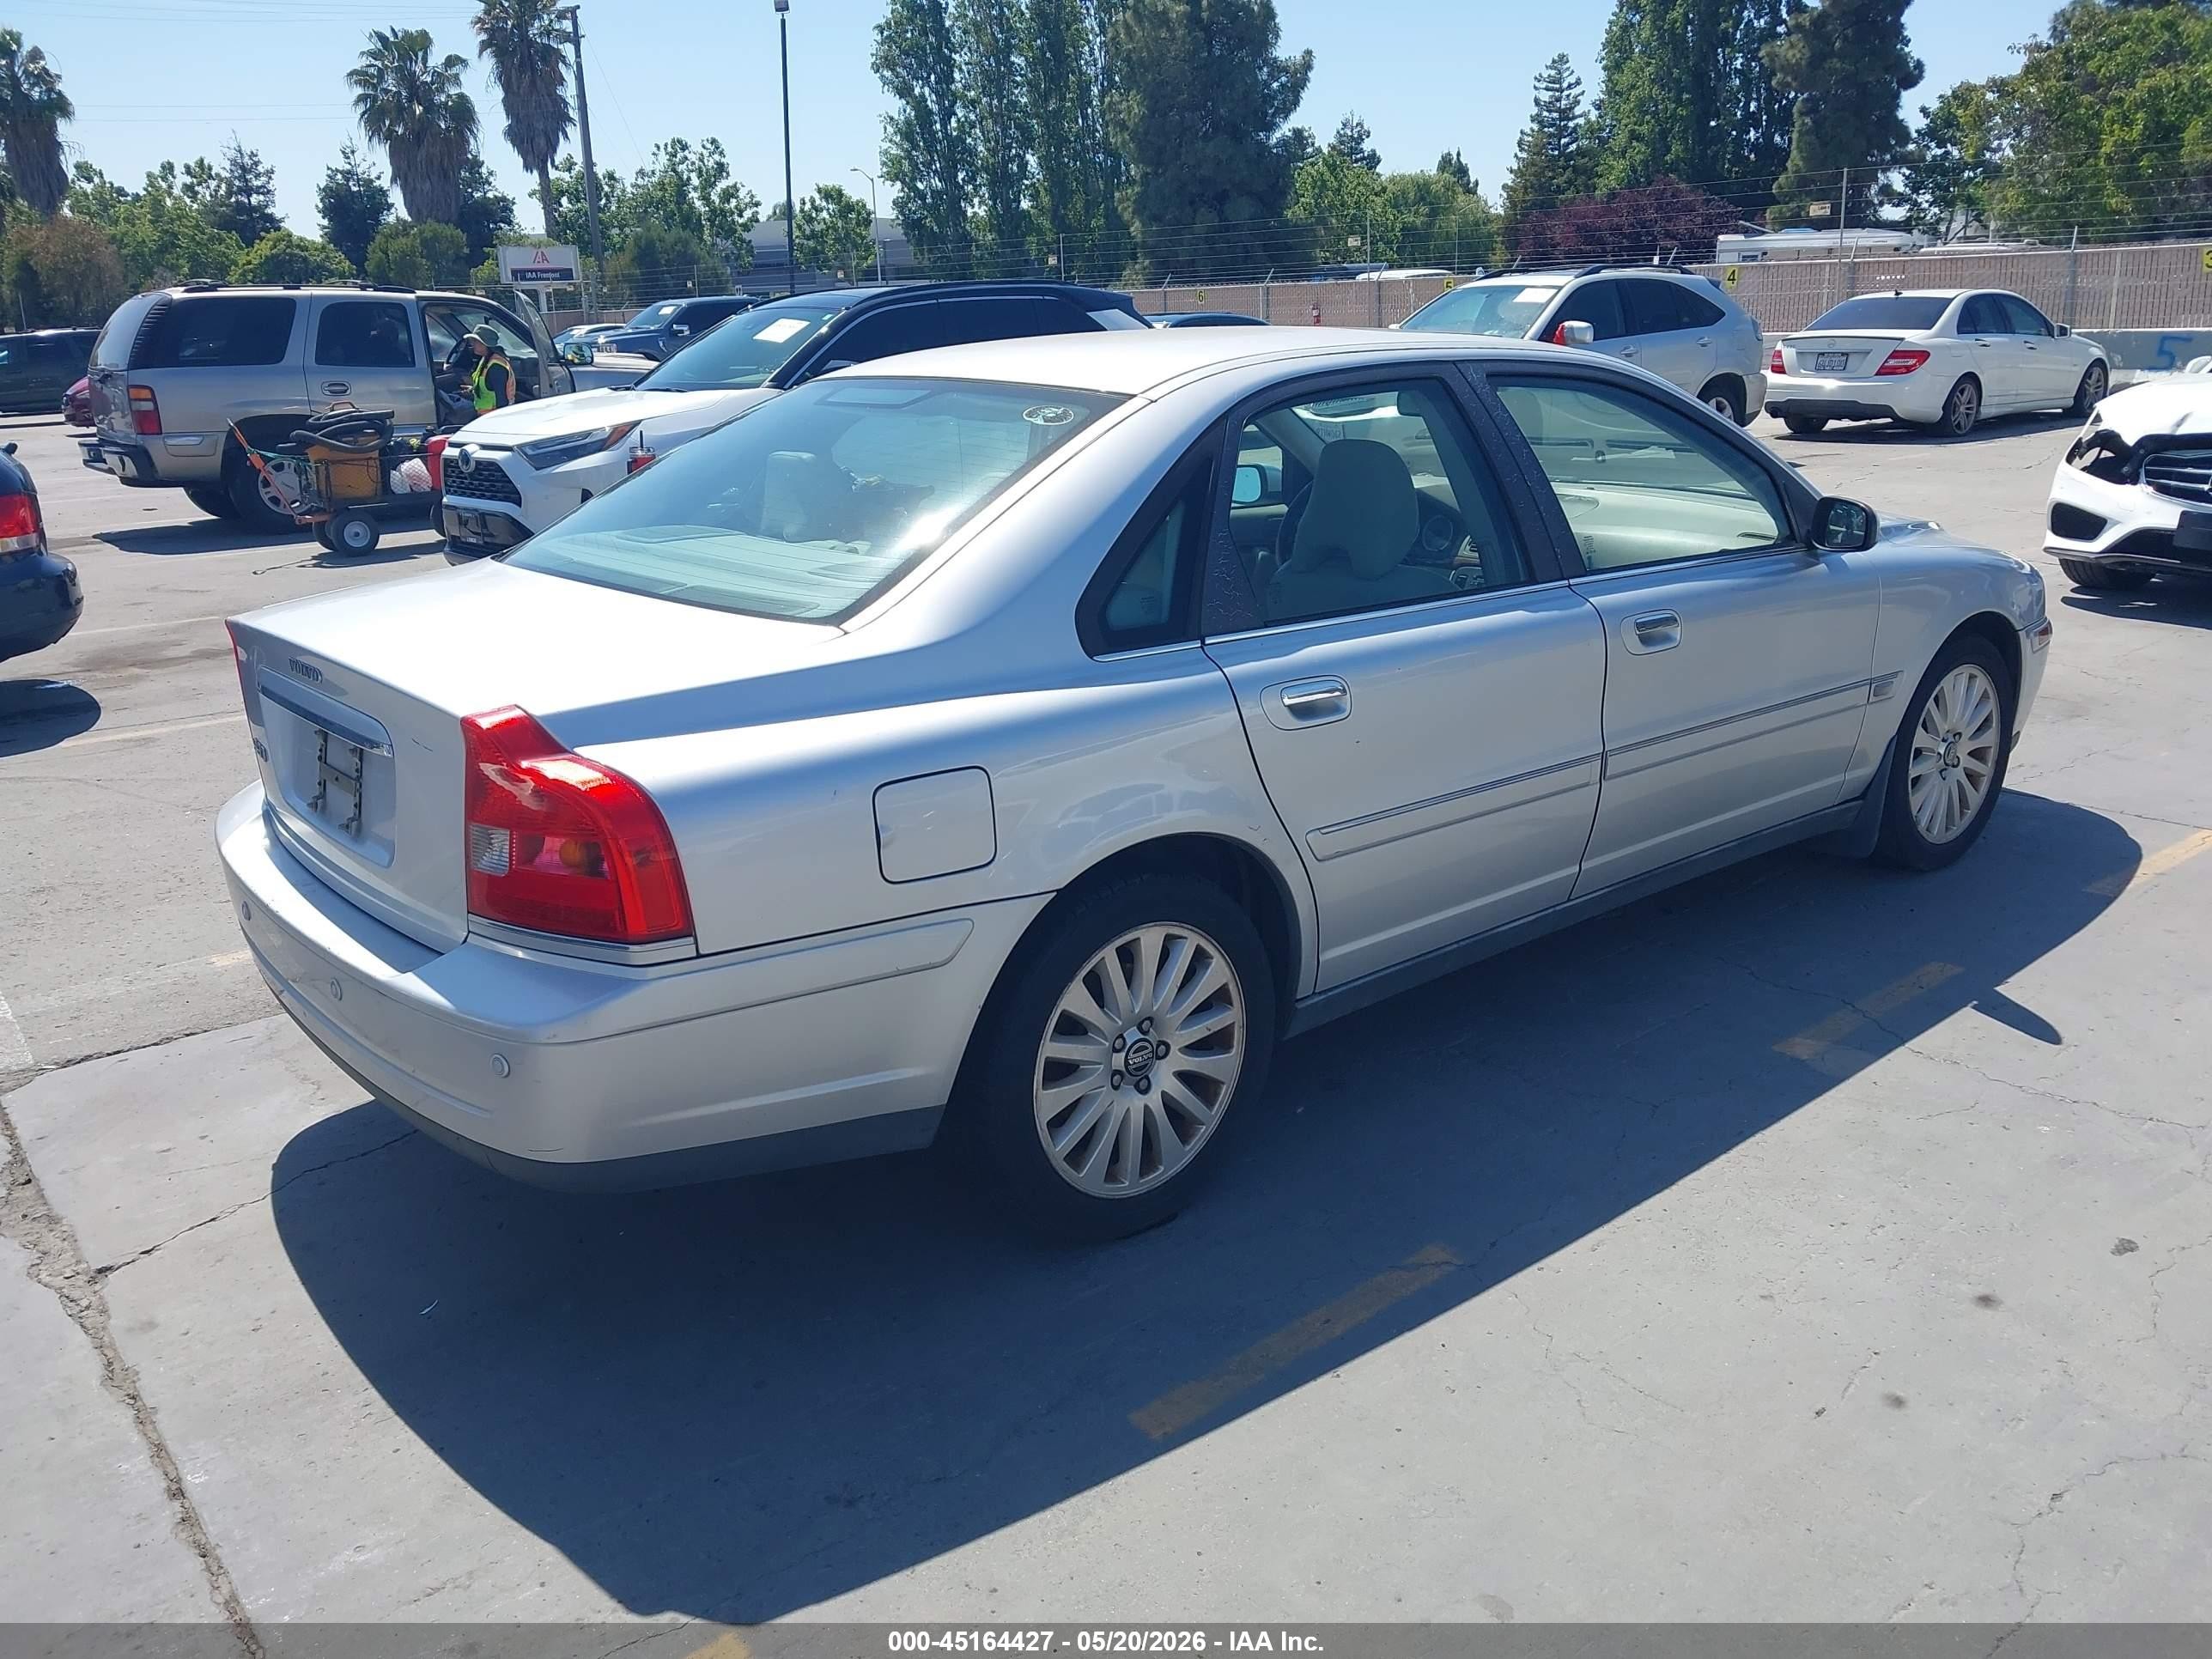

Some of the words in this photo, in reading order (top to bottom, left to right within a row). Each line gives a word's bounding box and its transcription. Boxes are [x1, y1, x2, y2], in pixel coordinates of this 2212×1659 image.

[1727, 269, 1736, 285] 4
[1198, 290, 1204, 302] 6
[2148, 335, 2193, 370] 5
[288, 657, 323, 684] VOLVO
[1127, 1052, 1153, 1065] VOLVO
